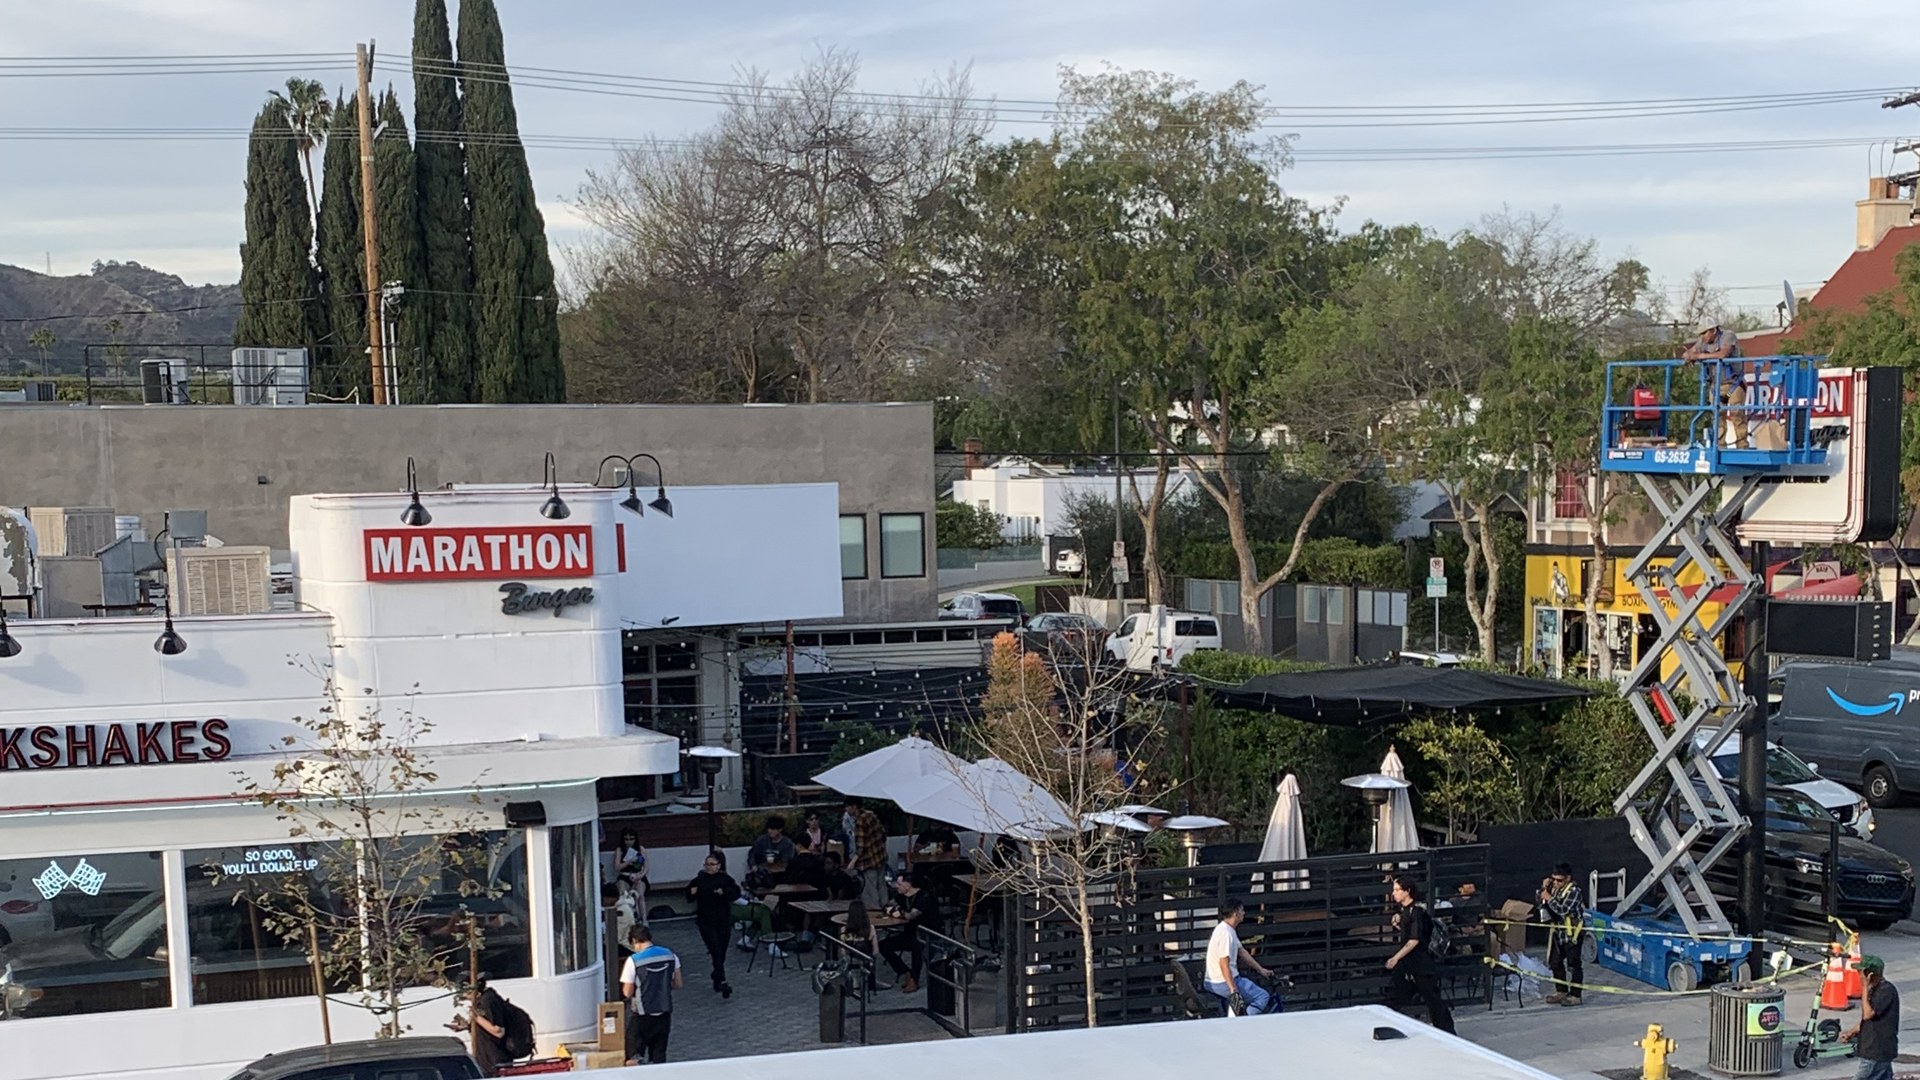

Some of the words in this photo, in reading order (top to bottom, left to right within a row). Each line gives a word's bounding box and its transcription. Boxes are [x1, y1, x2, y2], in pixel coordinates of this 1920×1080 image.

[1654, 450, 1690, 464] GS-2632
[370, 533, 588, 574] MARATHON
[498, 582, 594, 618] Burger
[0, 718, 232, 770] KSHAKES
[222, 862, 259, 875] YOU'LL
[303, 859, 318, 871] UP
[245, 851, 261, 862] SO
[262, 849, 296, 861] GOOD,
